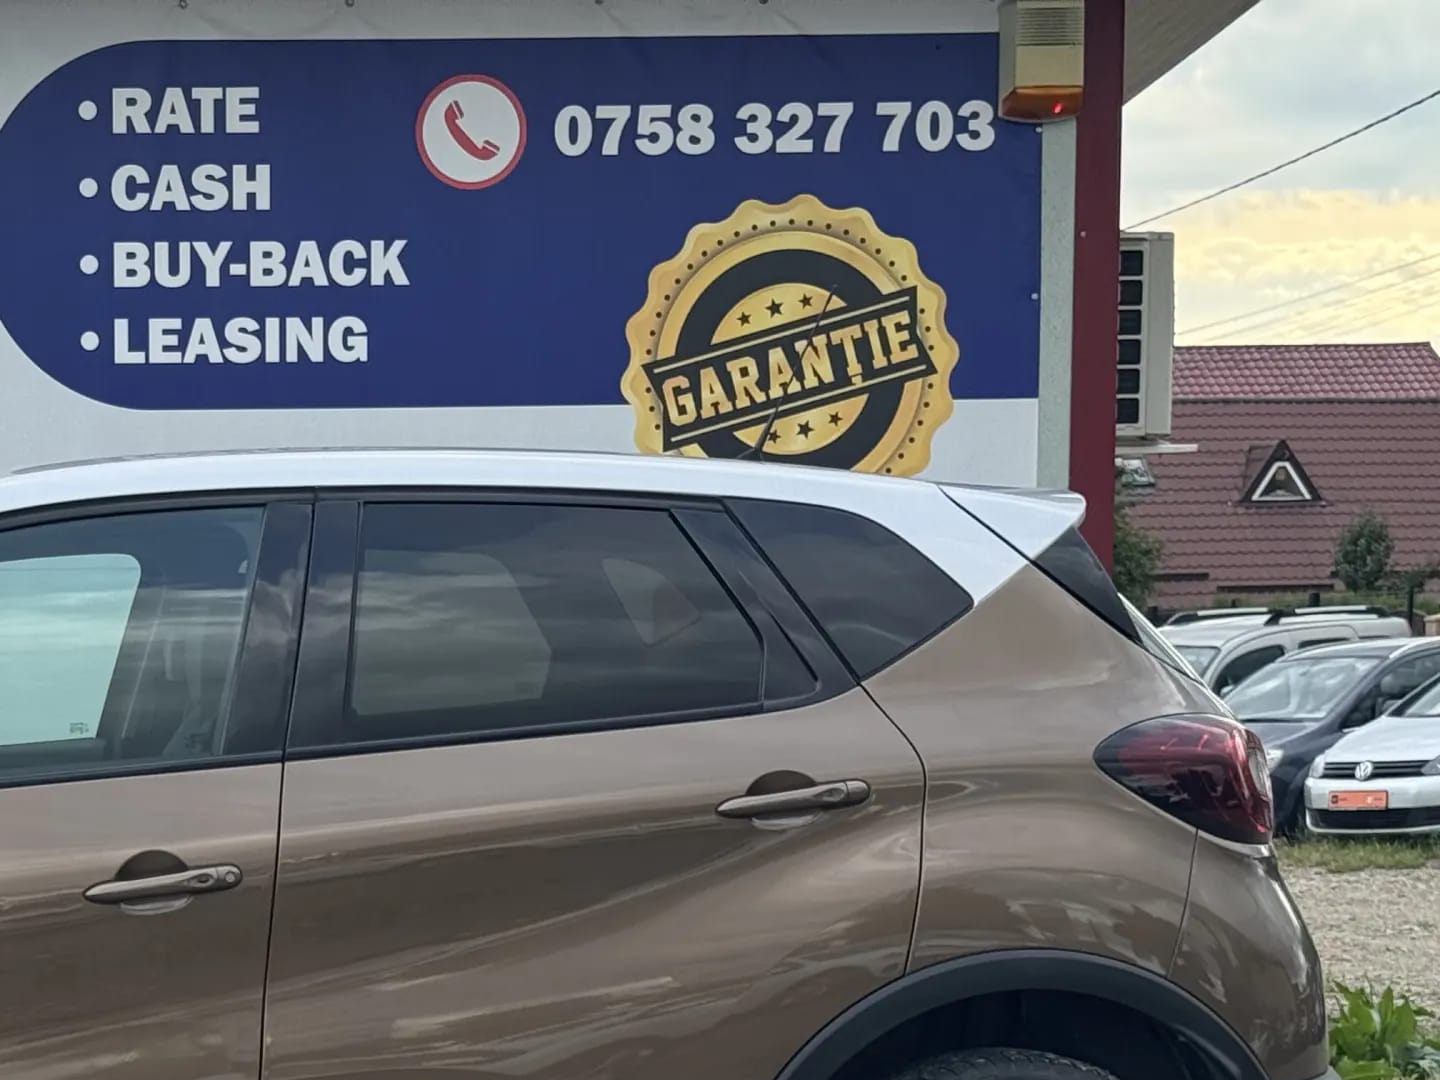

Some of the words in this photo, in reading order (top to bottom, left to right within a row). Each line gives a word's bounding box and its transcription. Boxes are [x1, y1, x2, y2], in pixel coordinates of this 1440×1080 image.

[111, 86, 261, 135] RATE
[553, 103, 715, 156] 0758
[733, 101, 851, 154] 327
[874, 99, 997, 153] 703
[110, 163, 272, 213] CASH
[111, 239, 410, 289] BUY-BACK
[112, 316, 368, 365] LEASING
